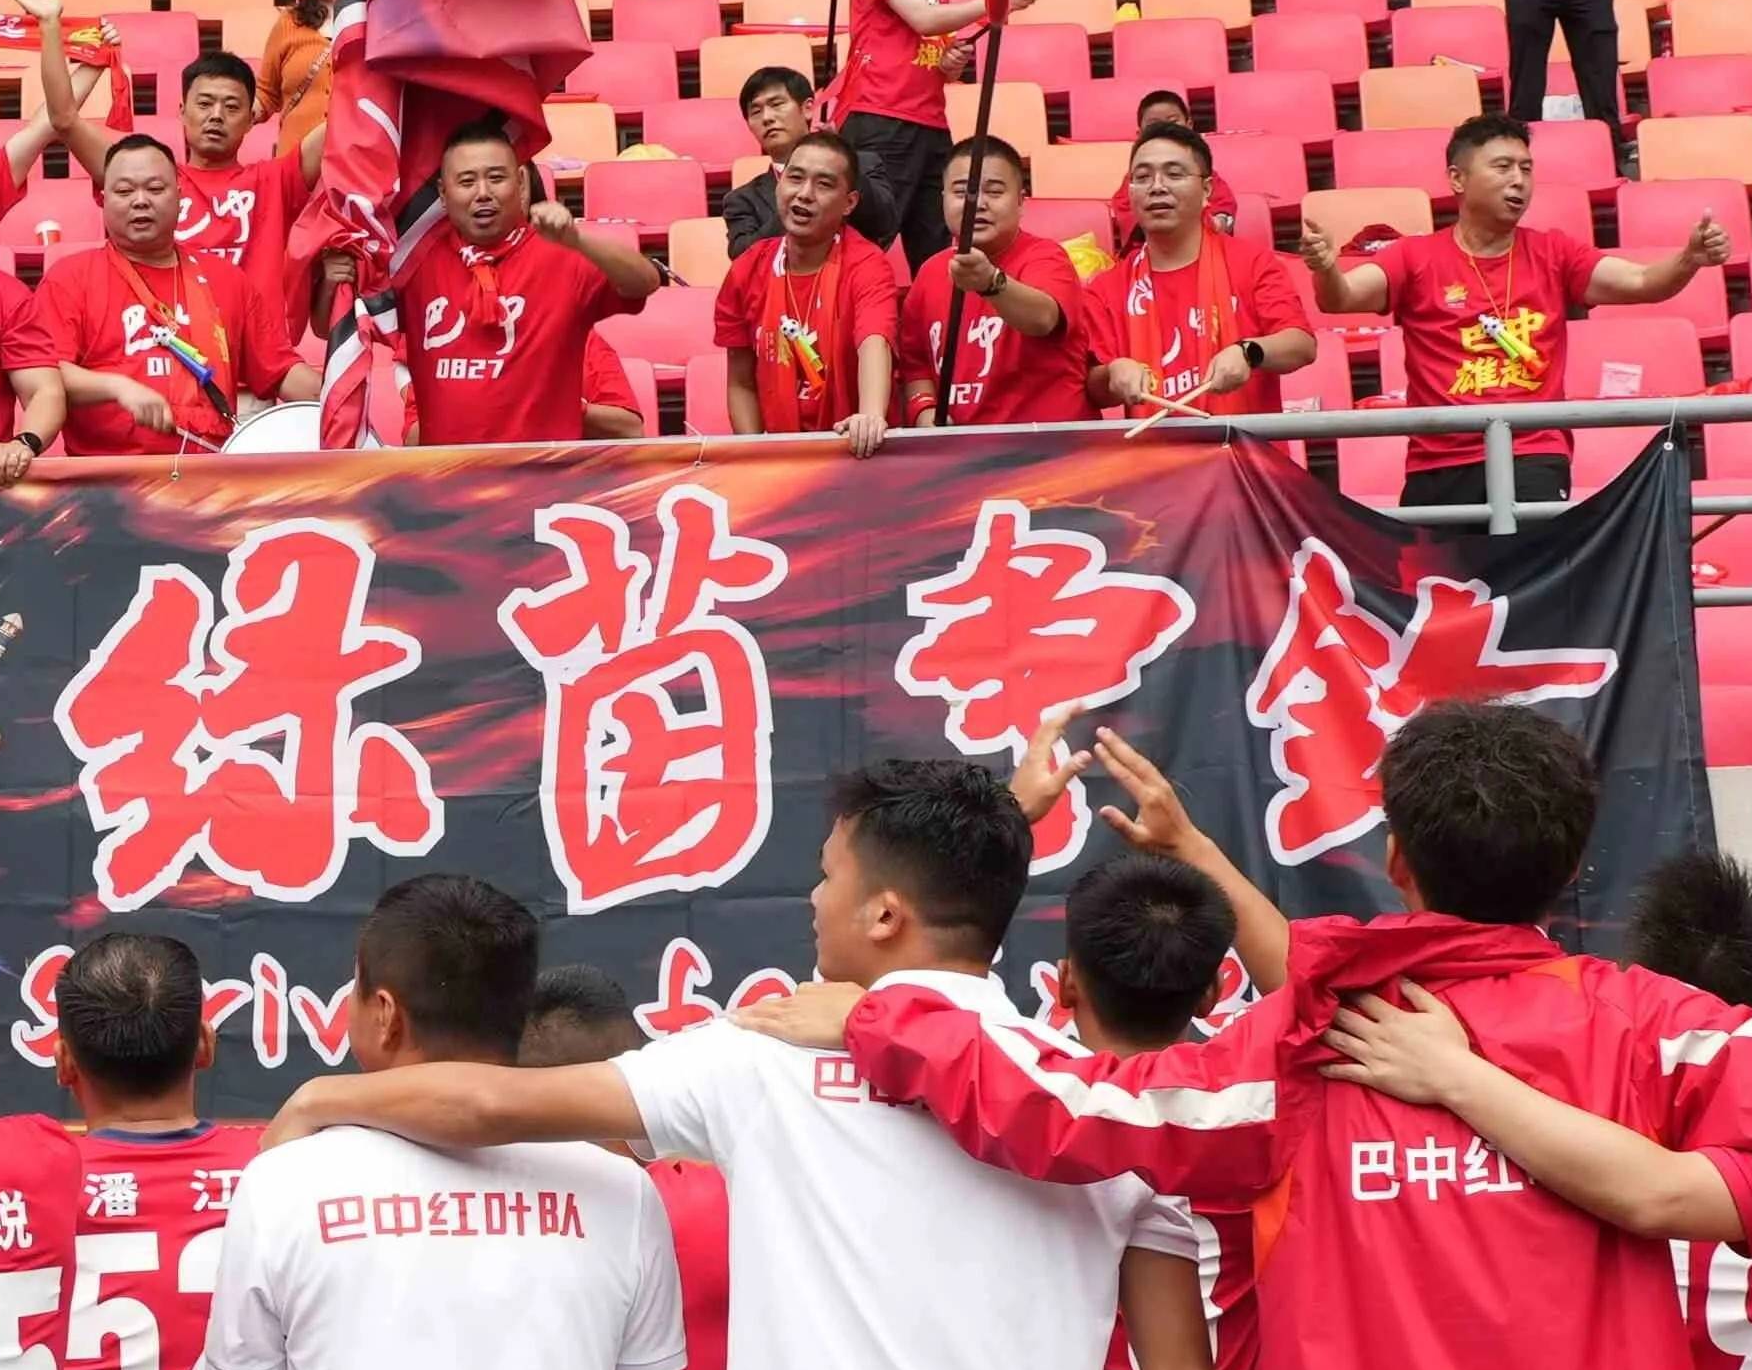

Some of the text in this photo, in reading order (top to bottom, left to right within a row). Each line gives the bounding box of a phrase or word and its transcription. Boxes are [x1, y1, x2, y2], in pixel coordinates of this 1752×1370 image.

[423, 295, 526, 355] 巴中
[435, 358, 506, 380] 0827
[1448, 355, 1543, 396] 雄起
[82, 1167, 244, 1219] 潘江
[317, 1189, 583, 1244] 巴中红叶队
